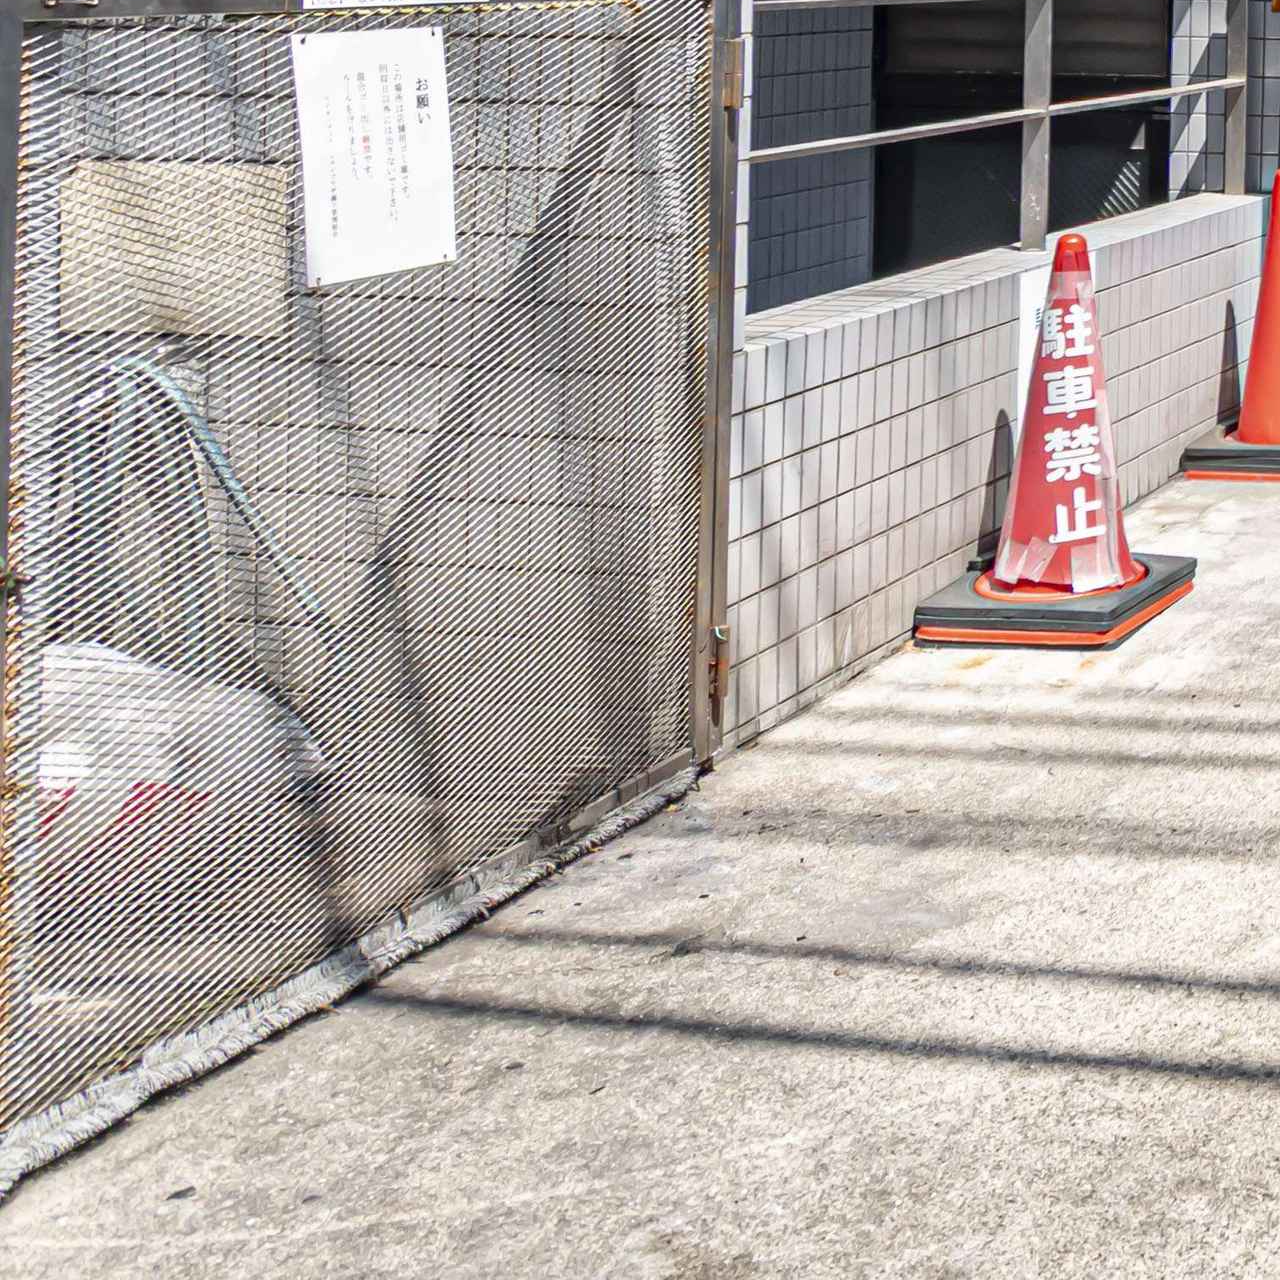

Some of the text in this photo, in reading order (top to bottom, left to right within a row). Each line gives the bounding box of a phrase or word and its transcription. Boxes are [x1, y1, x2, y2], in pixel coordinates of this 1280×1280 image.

[415, 78, 432, 124] お願い
[1041, 304, 1107, 544] 駐車禁止
